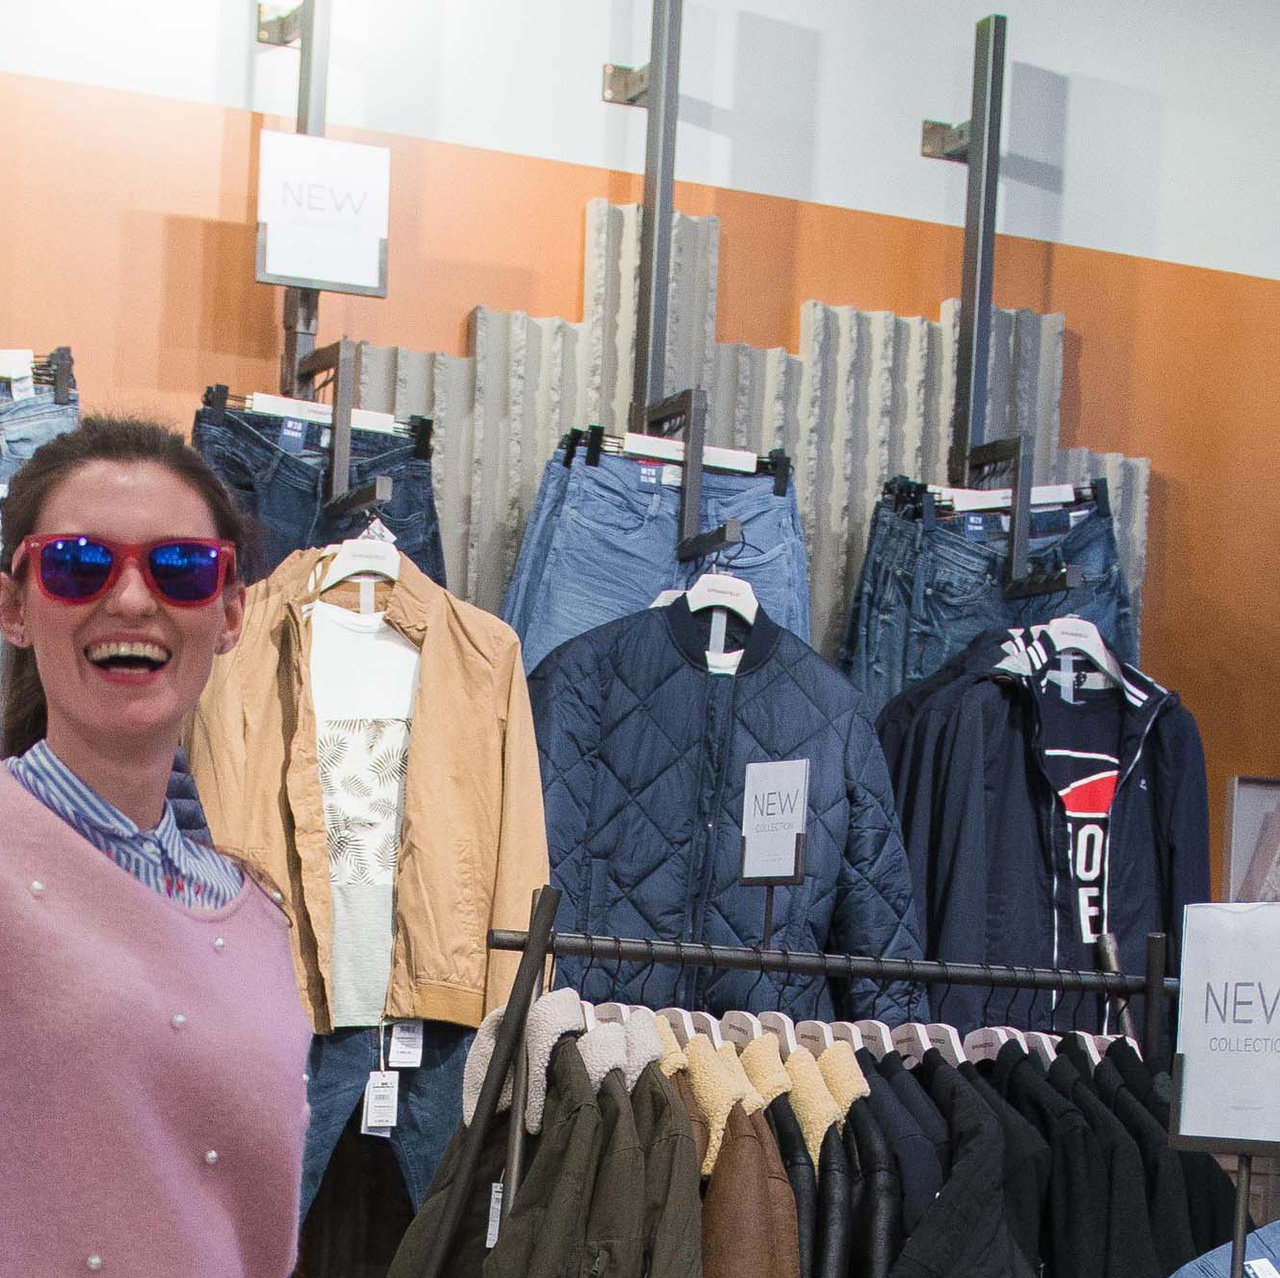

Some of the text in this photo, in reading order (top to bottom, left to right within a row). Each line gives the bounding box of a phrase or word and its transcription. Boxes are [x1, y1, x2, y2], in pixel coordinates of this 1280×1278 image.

[282, 181, 369, 215] NEW
[753, 789, 799, 817] NEW
[755, 821, 794, 833] COLLECTION
